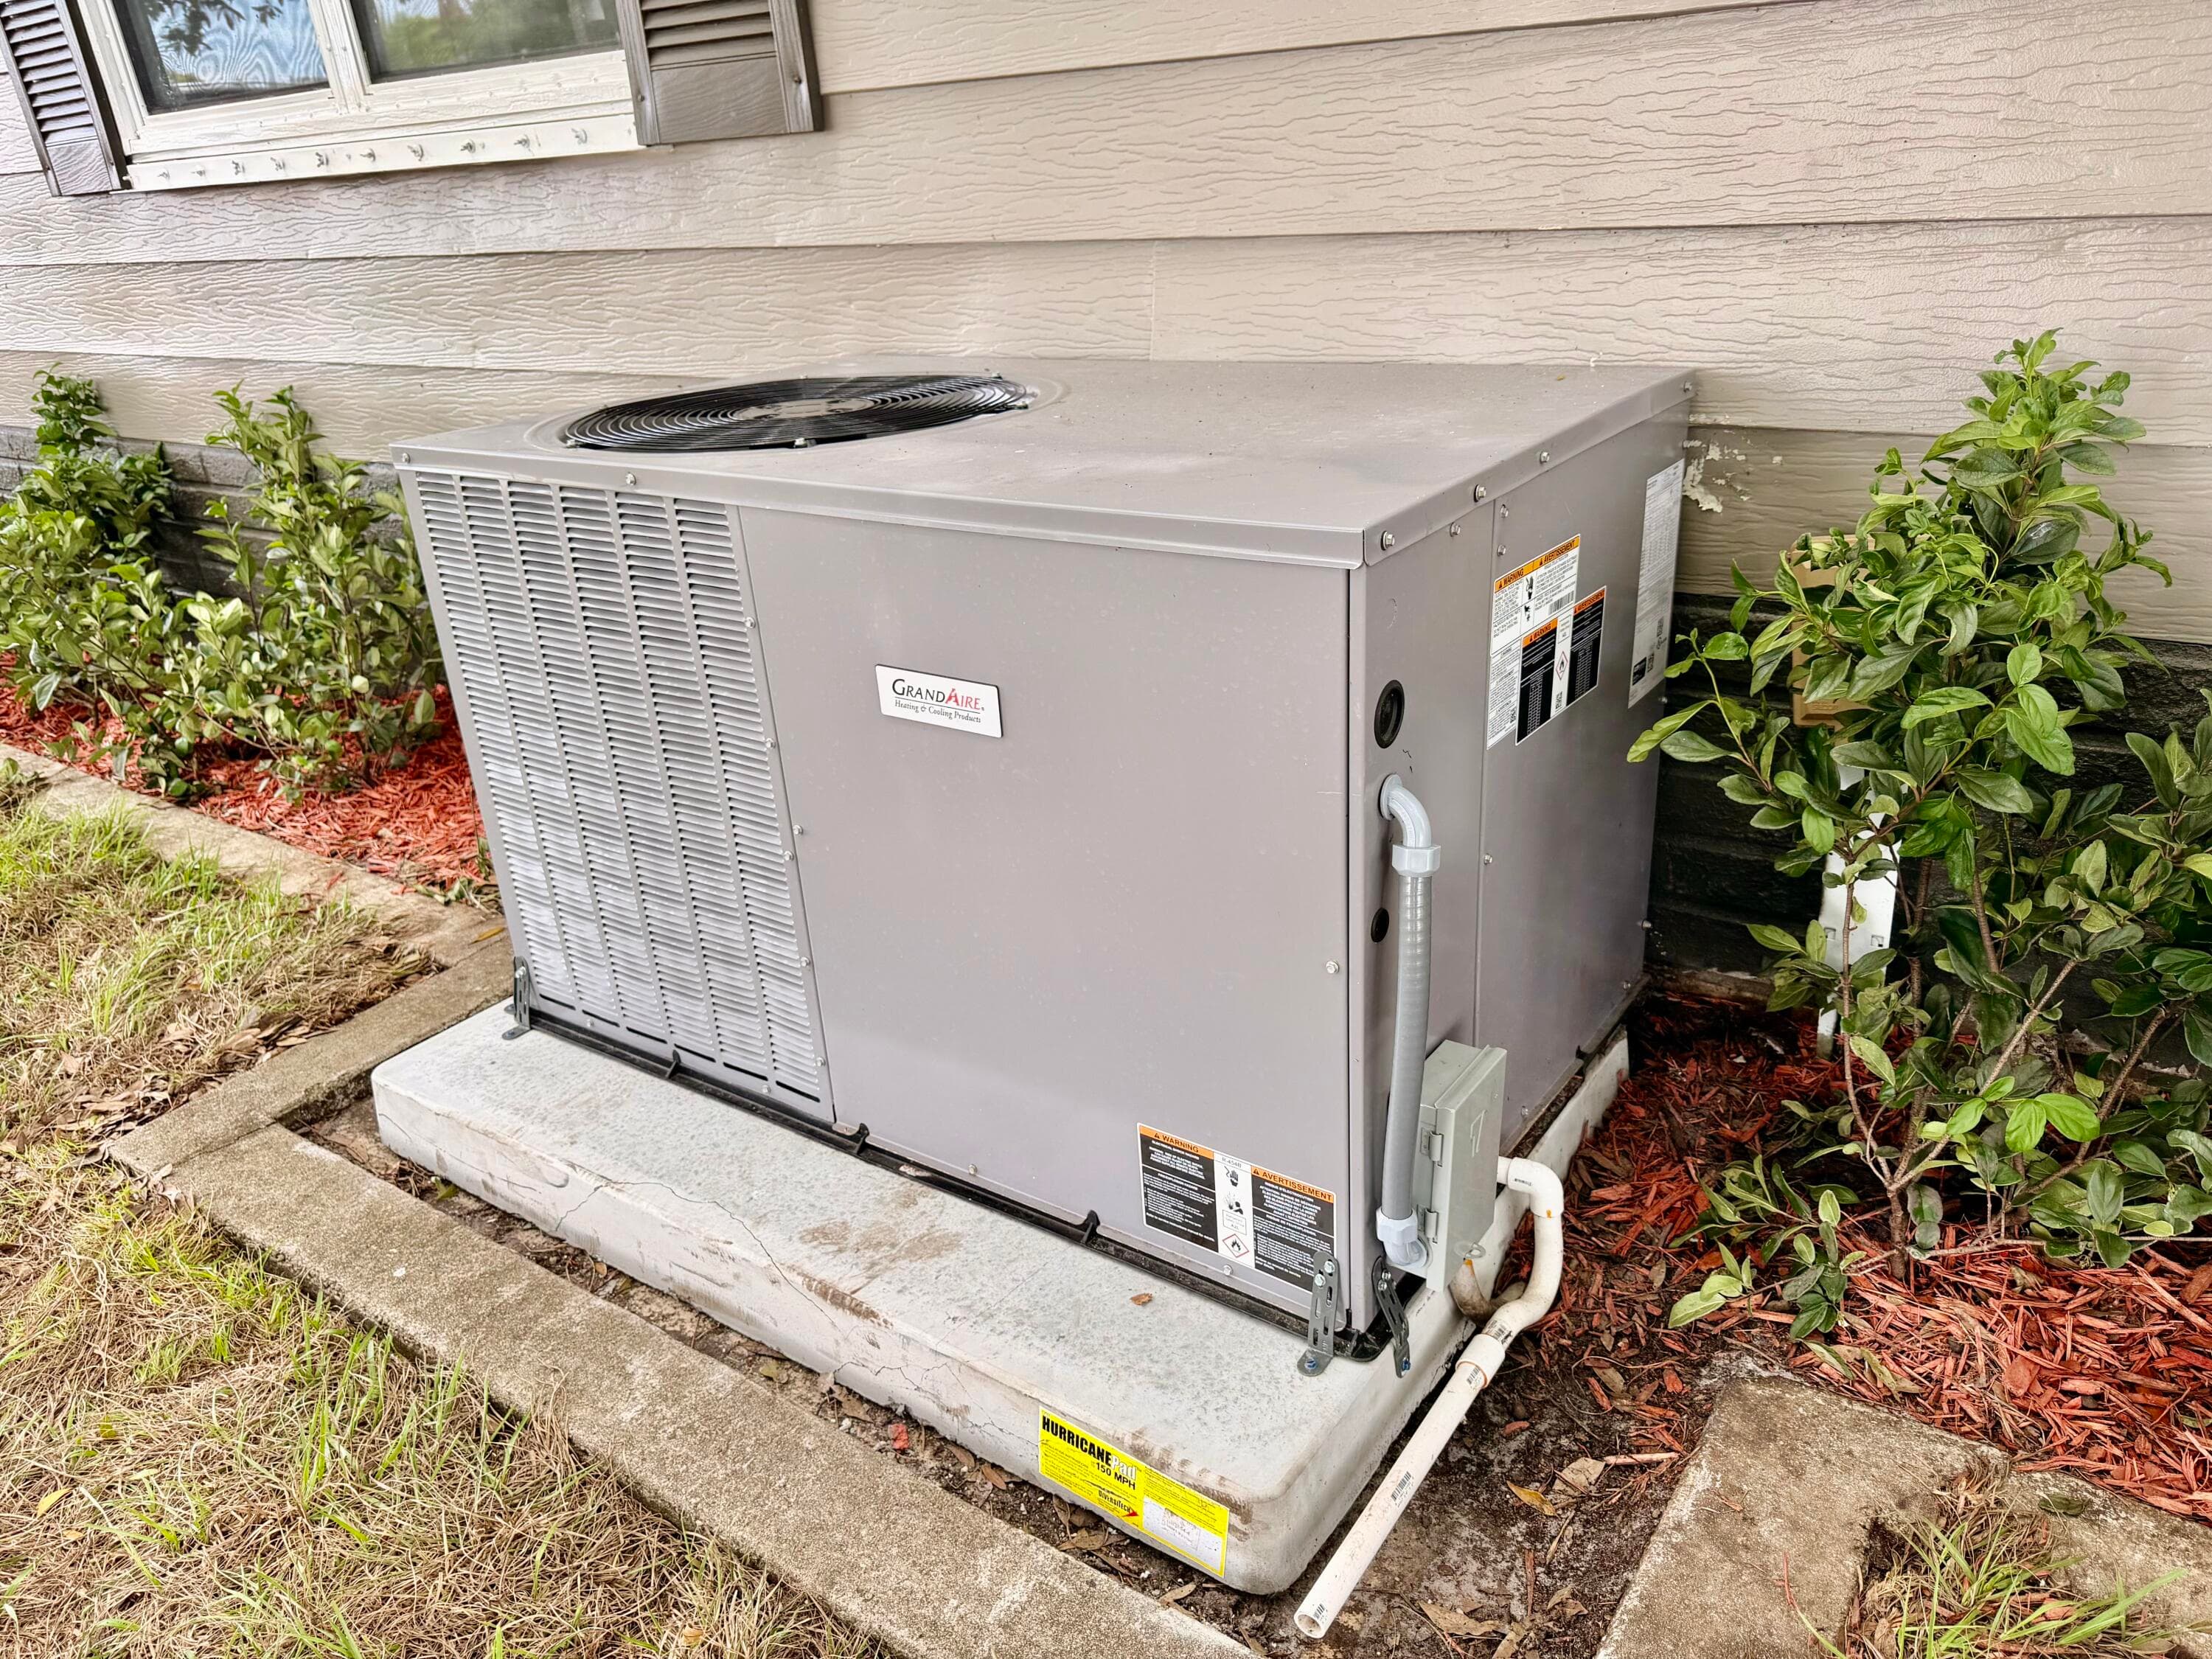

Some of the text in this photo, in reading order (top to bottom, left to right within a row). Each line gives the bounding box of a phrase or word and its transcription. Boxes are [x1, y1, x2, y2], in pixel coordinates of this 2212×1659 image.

[1503, 568, 1523, 586] WARNING
[895, 699, 981, 723] Heating & Cooling Products
[1162, 1135, 1199, 1153] WARNING
[1262, 1172, 1332, 1201] AVERTISSEMENT
[1096, 1462, 1112, 1477] 150
[1113, 1472, 1136, 1490] MPH
